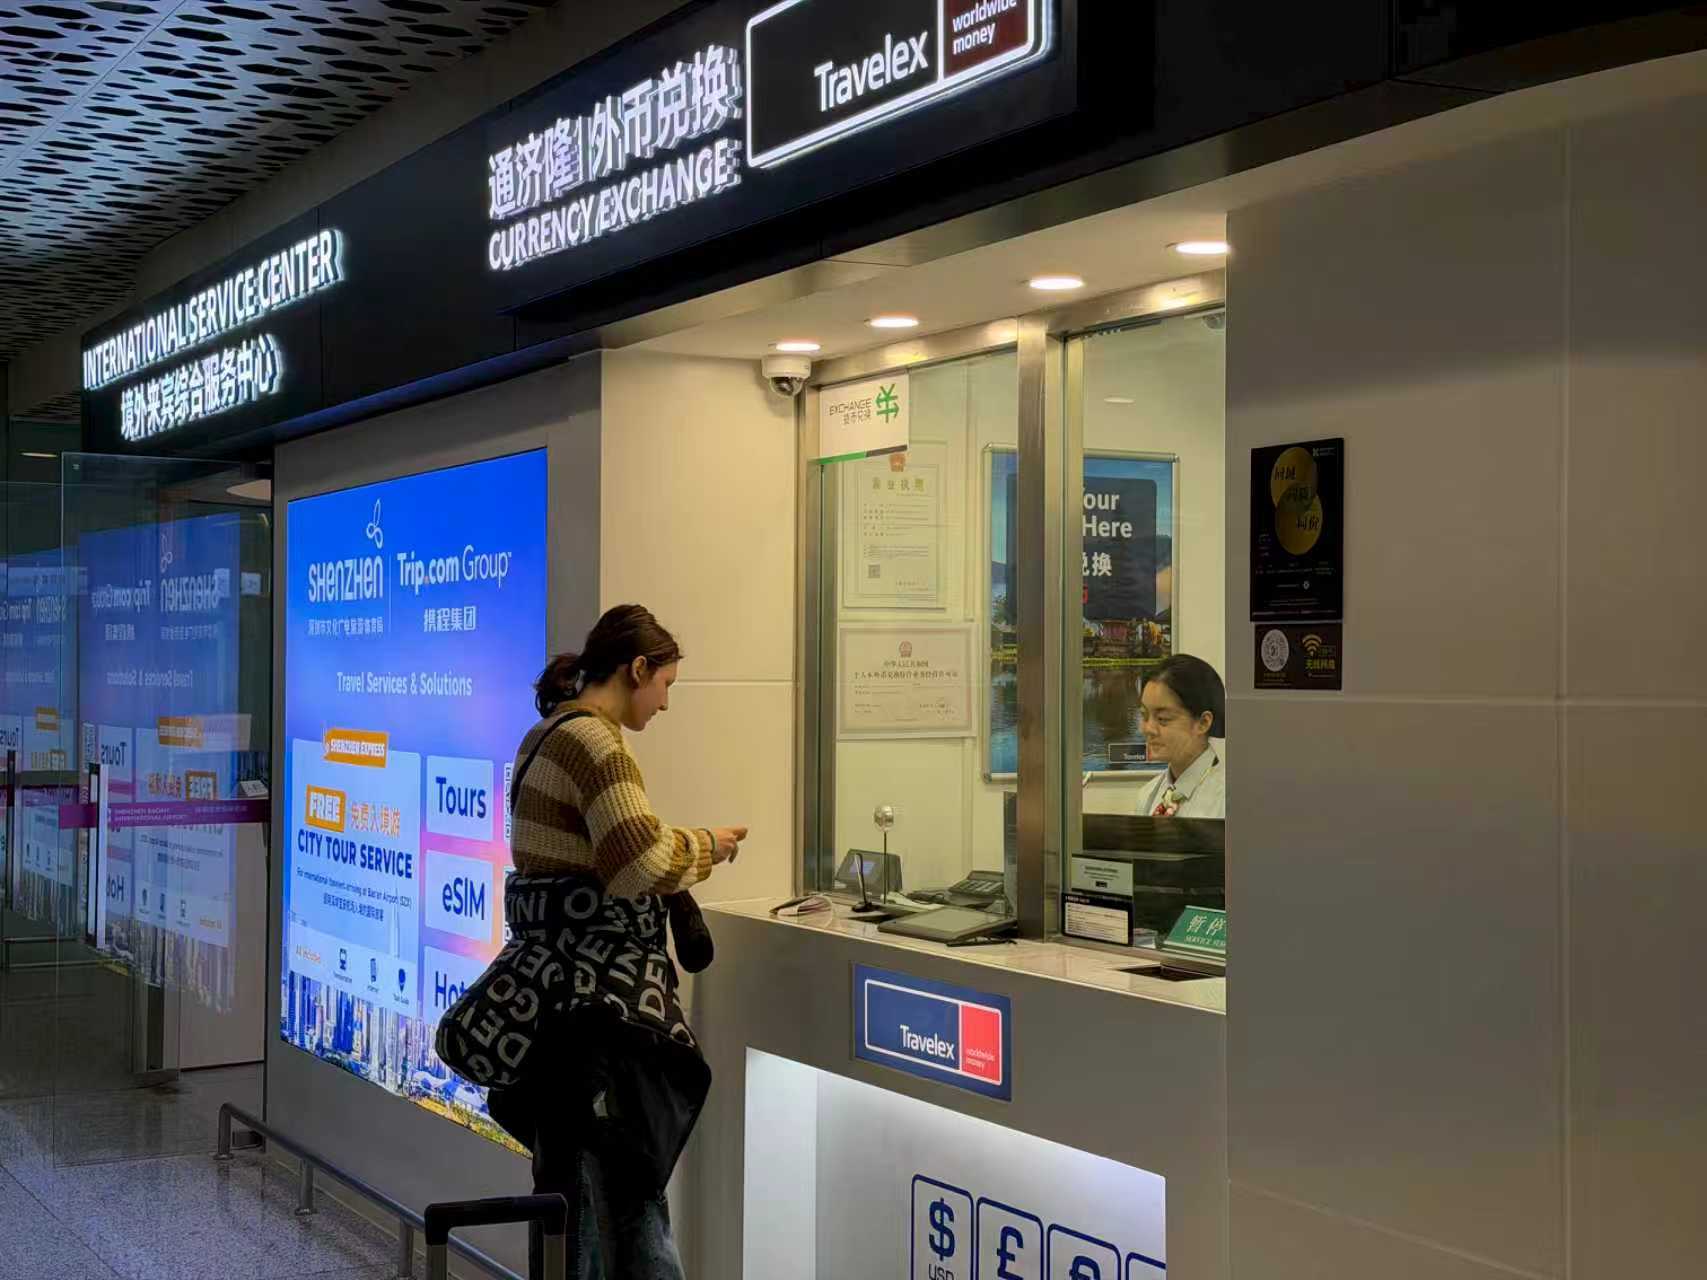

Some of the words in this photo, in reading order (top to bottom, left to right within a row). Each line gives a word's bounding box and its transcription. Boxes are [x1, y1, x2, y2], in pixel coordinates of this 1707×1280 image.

[952, 22, 996, 55] money
[813, 31, 929, 112] Travelex
[488, 116, 583, 220] 通济隆
[590, 44, 742, 181] 外币兑换
[488, 194, 596, 271] CURRENCY
[597, 138, 742, 233] EXCHANGE
[82, 303, 187, 391] INTERNATIONAL
[187, 268, 257, 344] SERVICE
[257, 229, 343, 312] CENTER
[829, 398, 872, 416] EXCHANGE
[1082, 487, 1120, 510] our
[1082, 515, 1132, 538] Here
[397, 551, 460, 595] Trip.com
[424, 606, 476, 632] 携程集团
[336, 672, 365, 694] Travel
[367, 672, 407, 695] Services
[410, 673, 418, 695] &
[420, 669, 473, 697] Solutions
[361, 742, 385, 758] EXPRESS
[309, 791, 341, 822] FREE
[435, 776, 487, 819] Tours
[297, 829, 322, 858] CITY
[325, 837, 356, 866] TOUR
[359, 843, 413, 880] SERVICE
[442, 876, 486, 920] eSIM
[899, 1024, 956, 1061] Travelex
[928, 1197, 955, 1262] $
